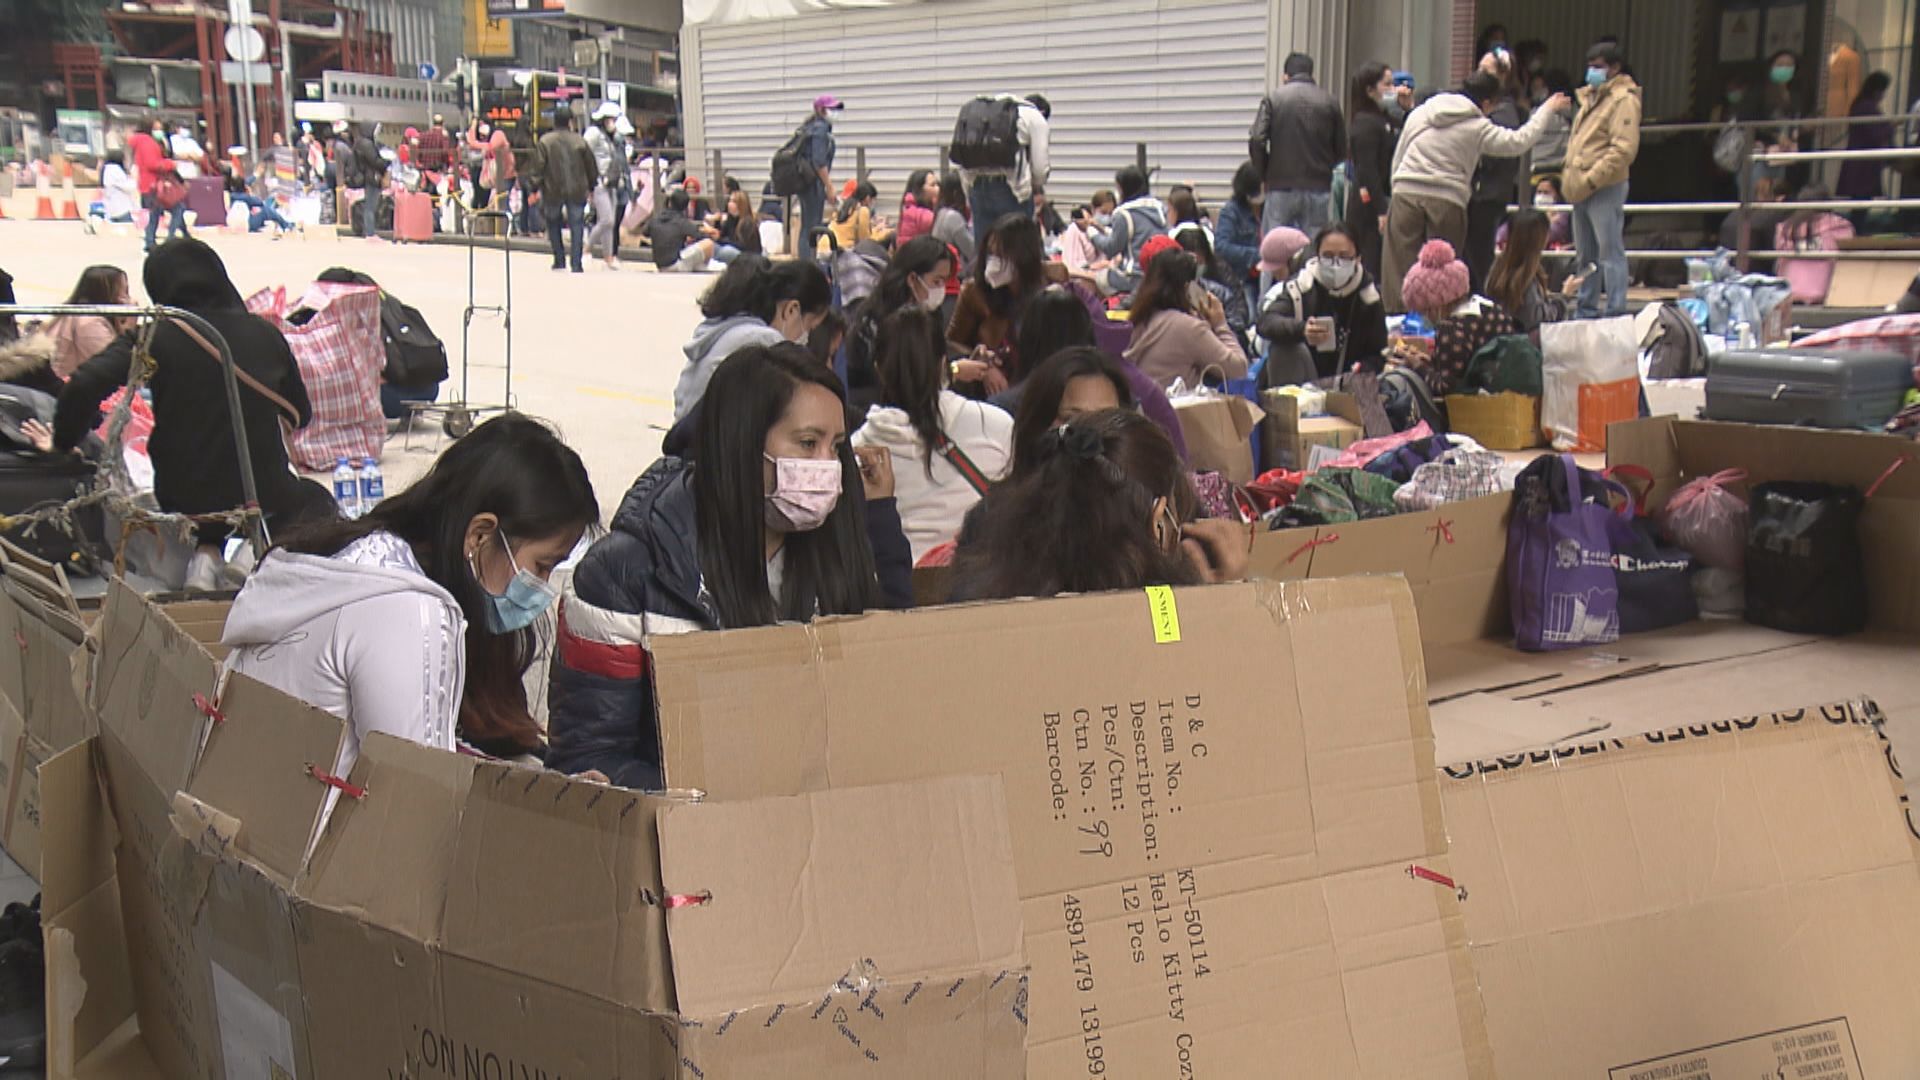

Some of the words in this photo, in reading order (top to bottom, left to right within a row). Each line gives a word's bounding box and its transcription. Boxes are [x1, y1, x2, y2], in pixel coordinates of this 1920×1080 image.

[1185, 694, 1200, 709] D
[1073, 708, 1090, 752] Ctn
[1188, 718, 1204, 734] &
[1101, 704, 1125, 812] Pcs/Ctn:
[1191, 743, 1208, 758] C
[1158, 698, 1174, 753] Item
[1177, 867, 1211, 979] KT-50114
[1043, 712, 1069, 821] Barcode:
[1063, 893, 1094, 992] 4891479
[1080, 1003, 1106, 1080] 13199
[1121, 883, 1140, 911] 12
[1129, 701, 1159, 861] Description:
[1149, 873, 1173, 944] Hello
[1162, 952, 1185, 1023] Kitty
[1176, 1033, 1193, 1080] Coz
[1127, 919, 1145, 964] Pcs
